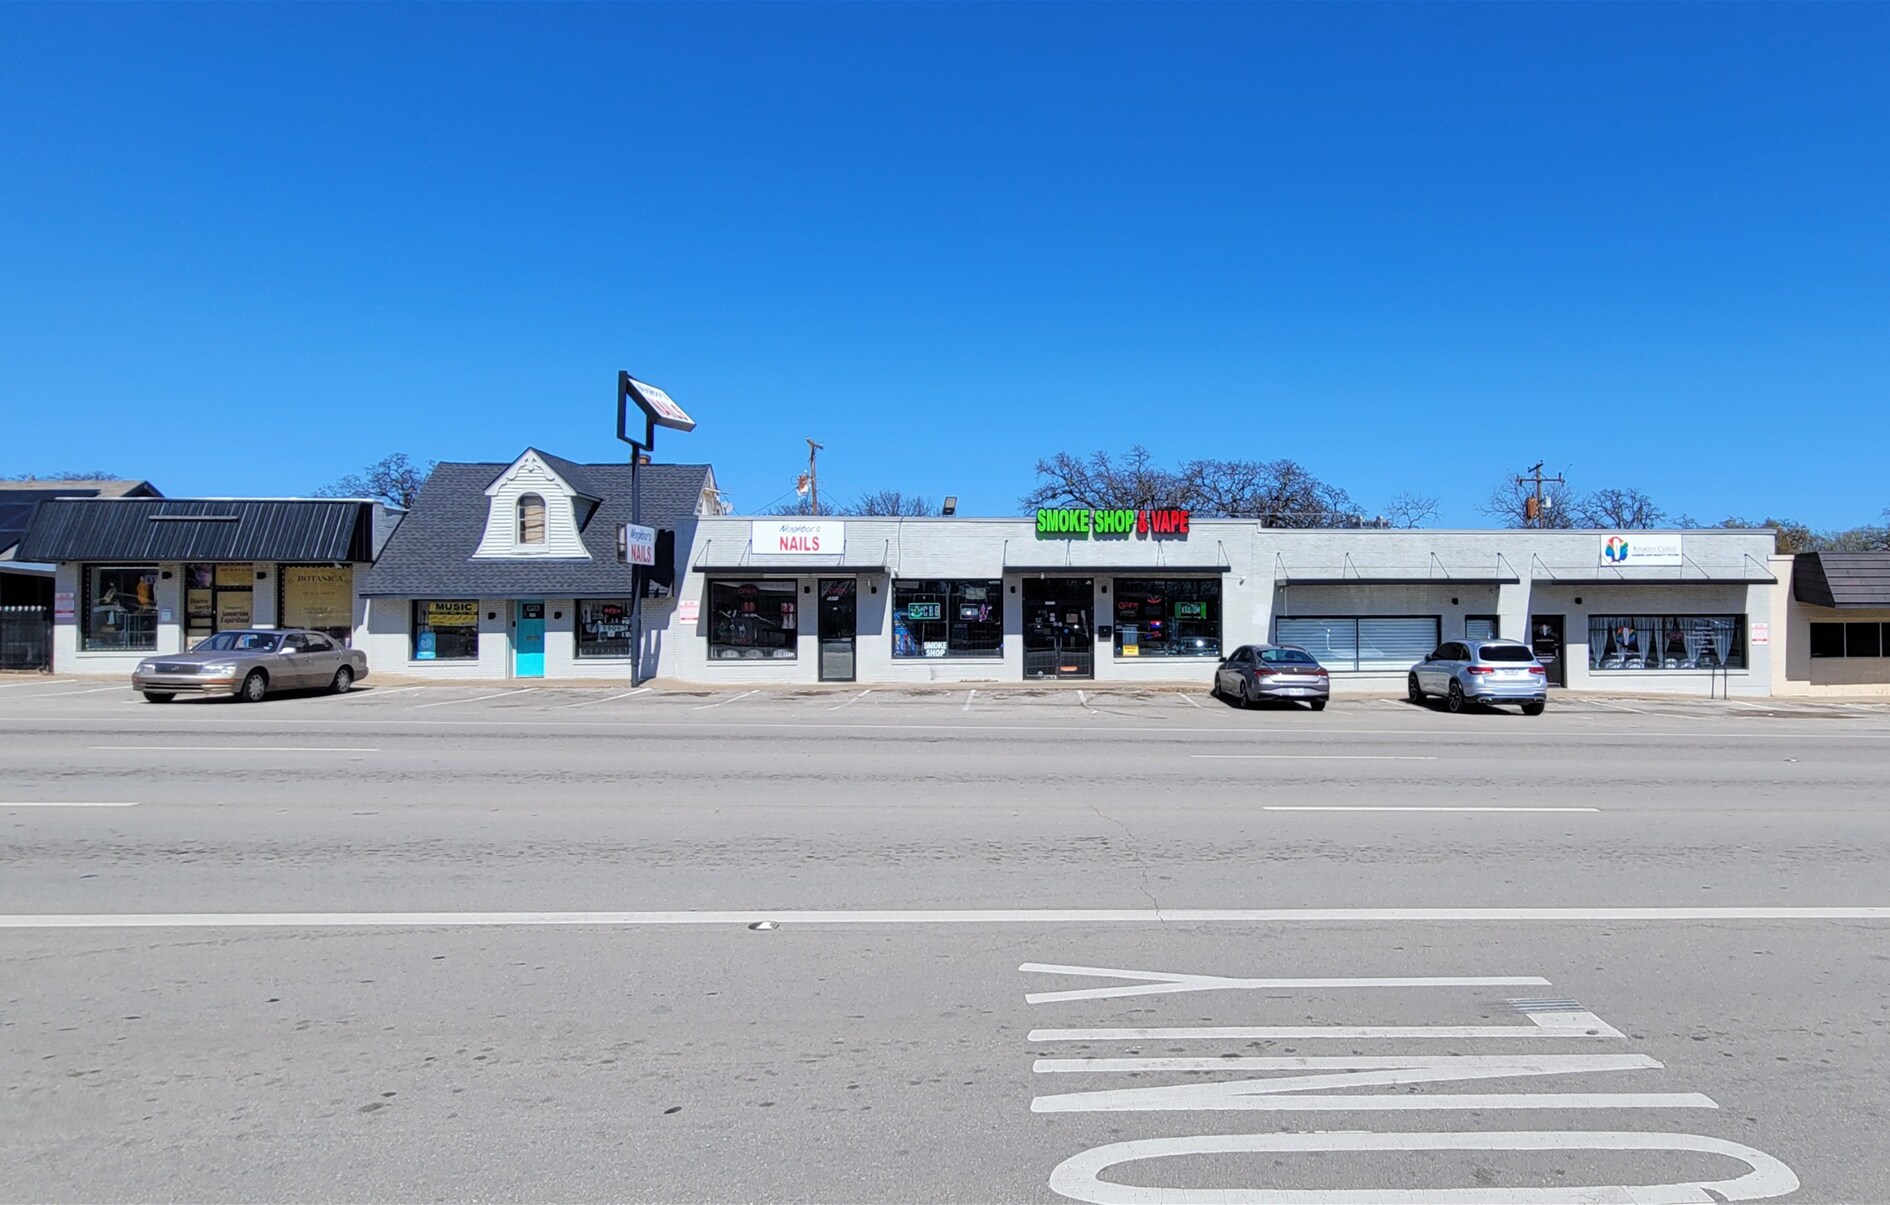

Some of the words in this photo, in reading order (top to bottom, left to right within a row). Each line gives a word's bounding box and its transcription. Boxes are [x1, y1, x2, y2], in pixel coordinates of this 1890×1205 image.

[1037, 509, 1089, 532] SMOKE
[1094, 510, 1134, 532] SHOP
[1137, 510, 1148, 533] &
[1150, 510, 1189, 533] VAPE
[779, 536, 820, 551] NAILS
[631, 543, 651, 563] NAILS
[924, 641, 948, 650] SMOKE
[926, 649, 946, 657] SHOP
